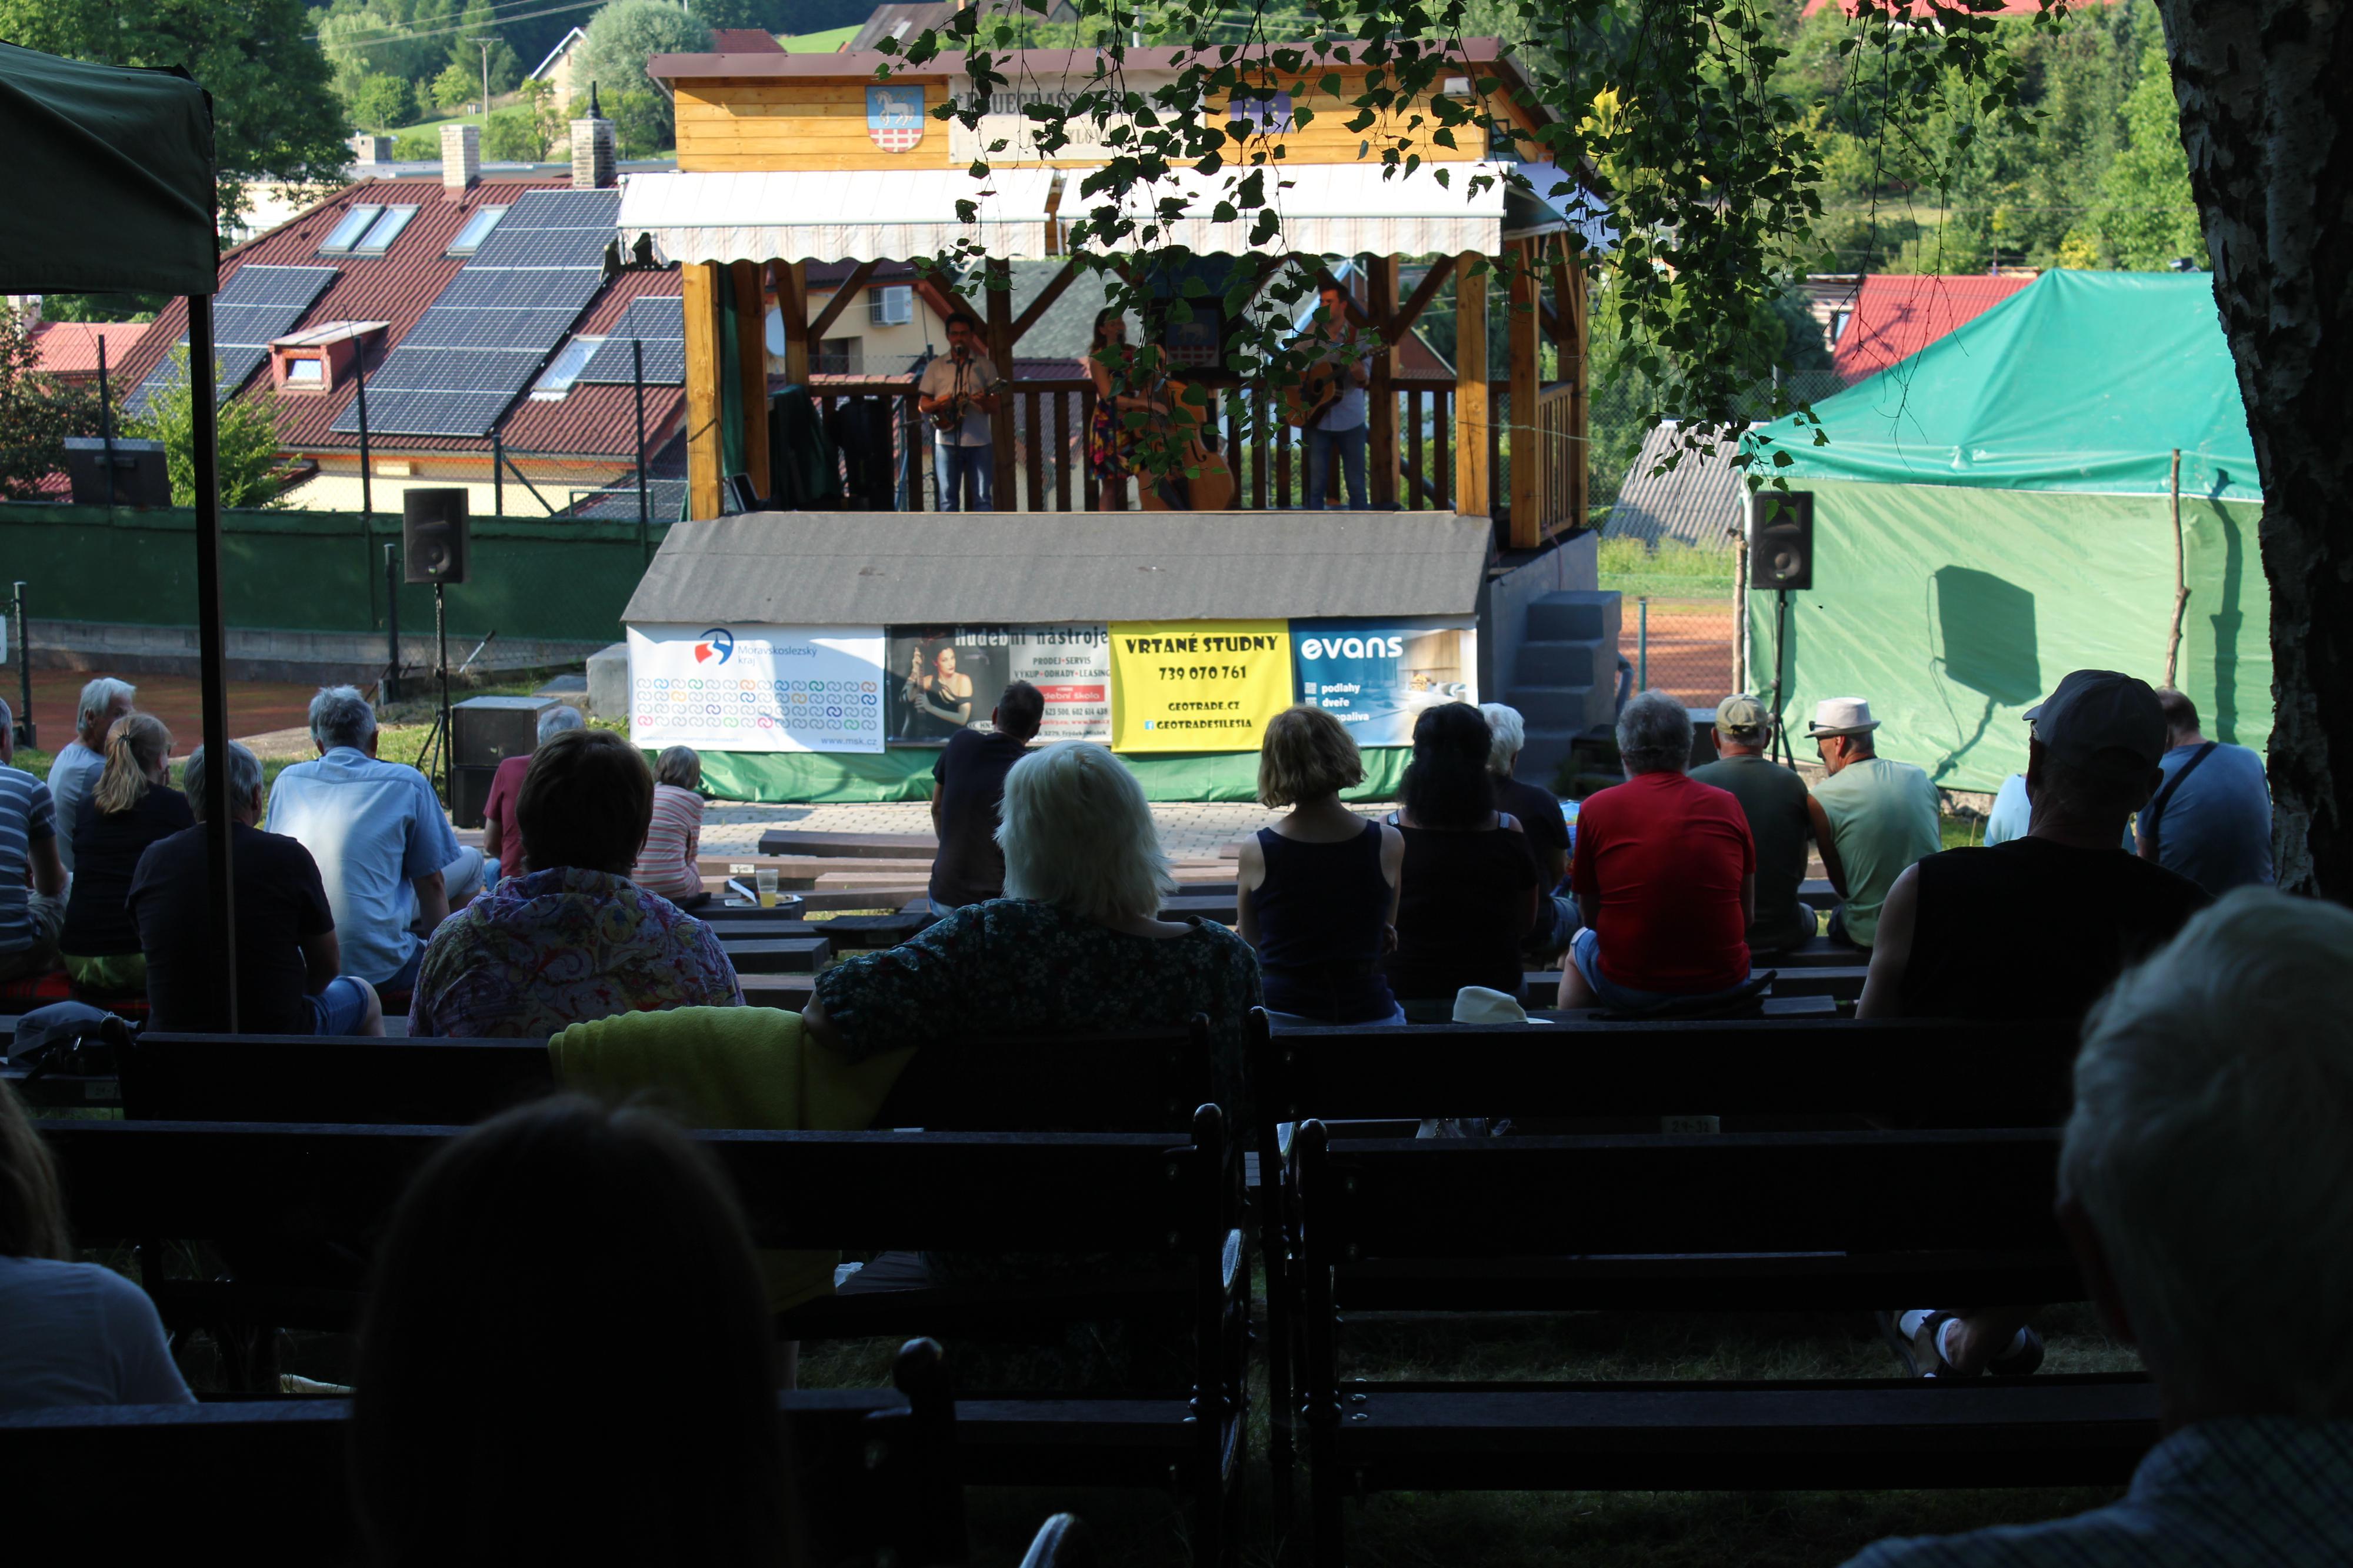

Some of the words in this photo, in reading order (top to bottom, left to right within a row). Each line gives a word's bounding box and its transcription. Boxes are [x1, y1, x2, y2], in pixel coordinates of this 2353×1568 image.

[1036, 626, 1108, 648] nástroje
[1125, 633, 1198, 654] VRTANÉ
[1203, 635, 1278, 652] STUDNY
[1301, 636, 1404, 660] evans
[738, 655, 755, 666] kraj
[1159, 667, 1185, 680] 739
[1189, 666, 1217, 679] 070
[1221, 665, 1247, 679] 761
[1321, 683, 1361, 695] podlahy
[1168, 701, 1240, 712] GEOTRADE.CZ
[1322, 697, 1350, 707] dveře
[1156, 719, 1252, 730] GEOTRADESILESIA
[821, 738, 877, 746] www.msk.cz
